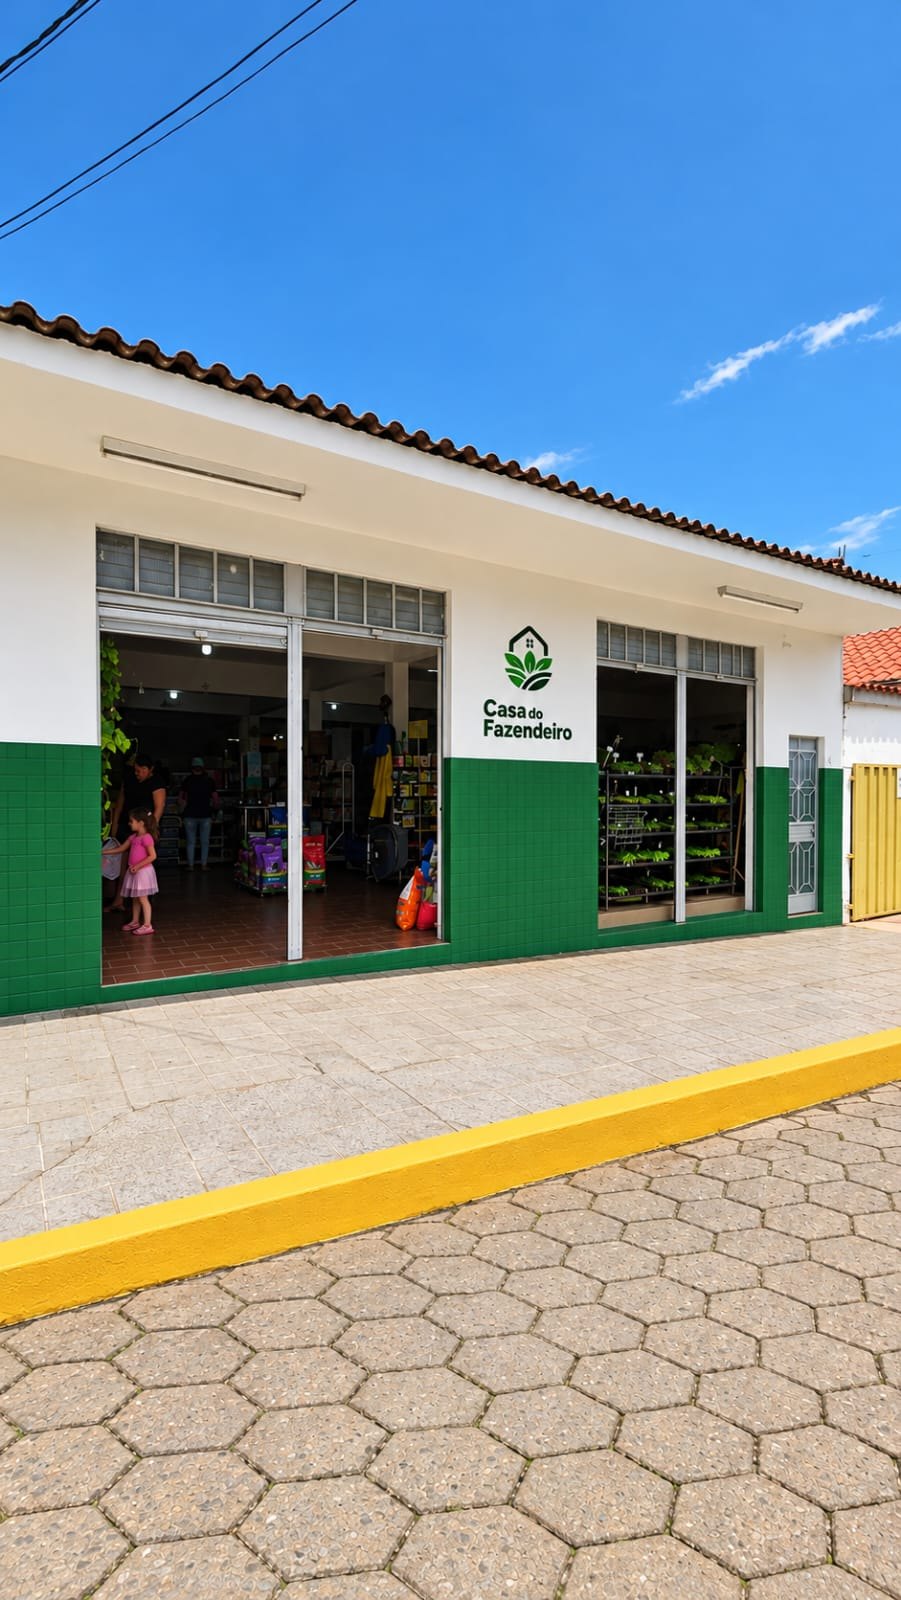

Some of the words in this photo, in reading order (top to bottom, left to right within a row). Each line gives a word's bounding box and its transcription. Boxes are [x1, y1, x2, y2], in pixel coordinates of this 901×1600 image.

[483, 699, 526, 719] Casa
[528, 707, 544, 719] do
[483, 719, 572, 740] Fazendeiro
